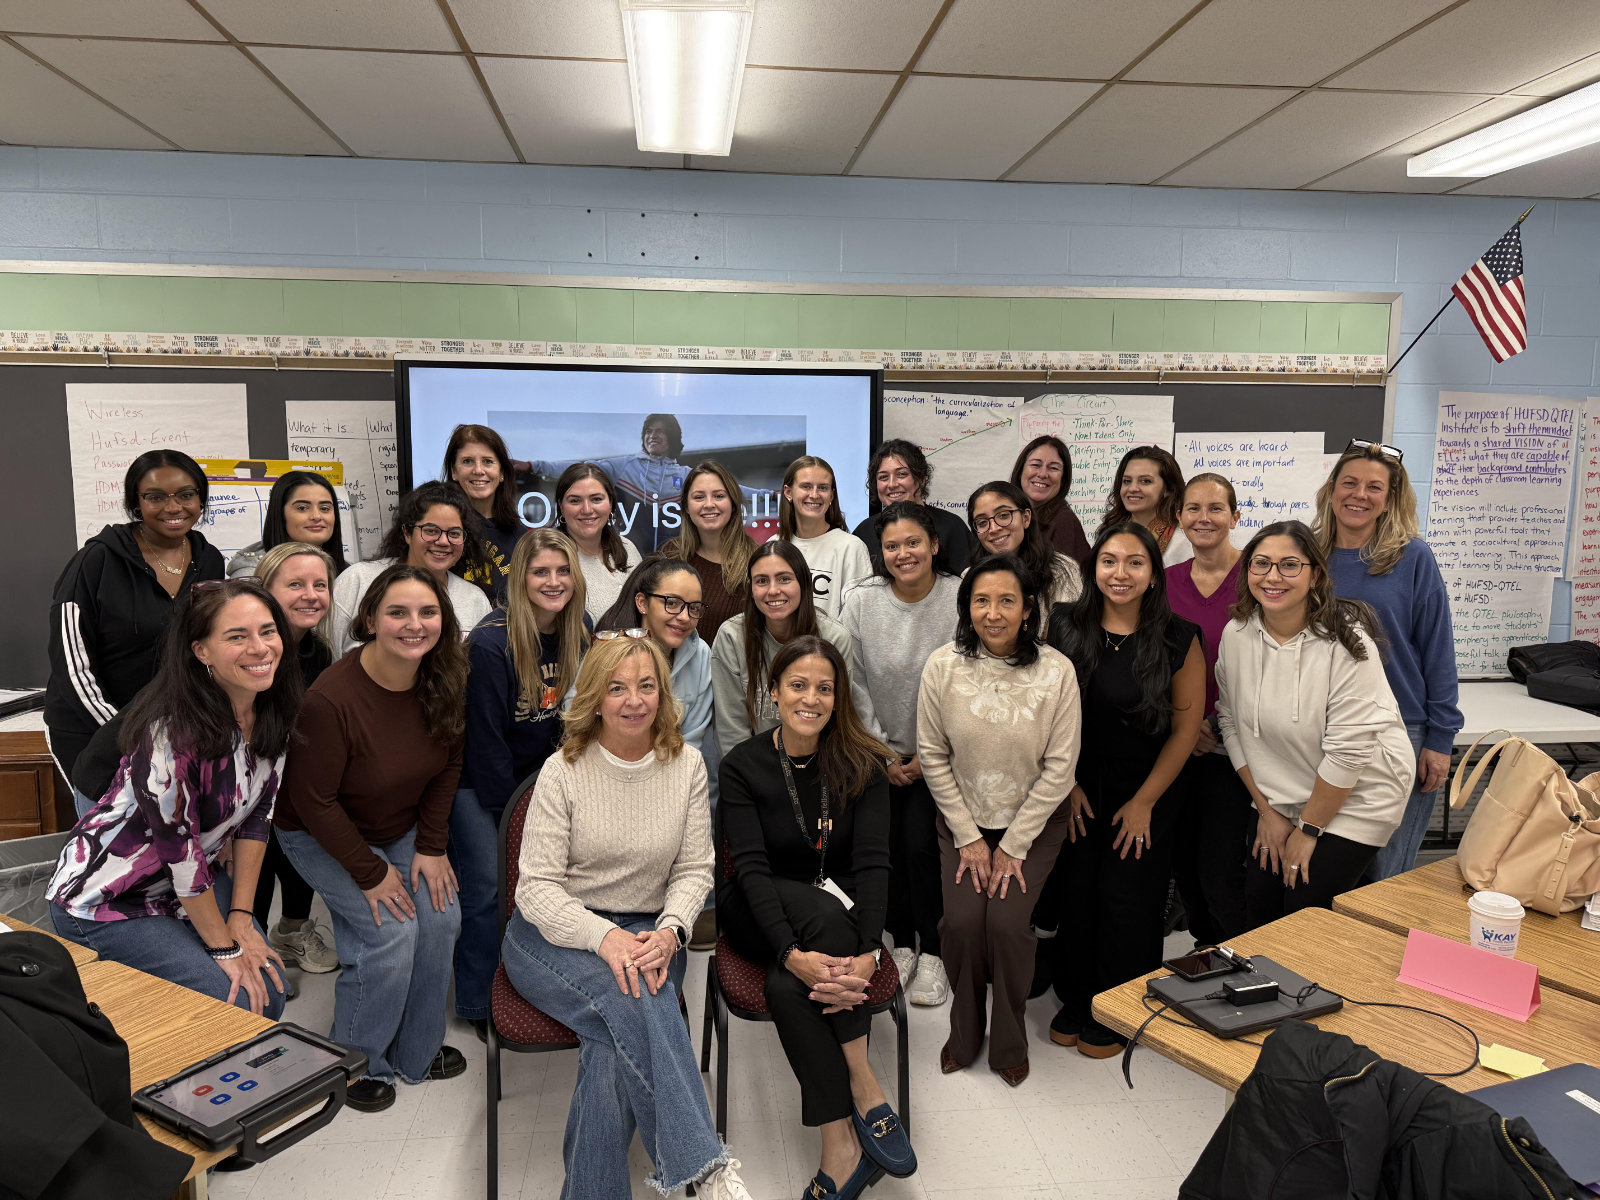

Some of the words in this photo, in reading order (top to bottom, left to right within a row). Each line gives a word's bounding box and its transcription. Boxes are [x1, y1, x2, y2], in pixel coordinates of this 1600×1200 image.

[1050, 396, 1064, 408] The
[1077, 395, 1108, 409] Circuit
[84, 401, 143, 419] Wireless
[1442, 404, 1461, 419] The
[1464, 409, 1498, 425] purpose
[1501, 407, 1512, 420] of
[1514, 407, 1548, 423] HUFSD
[1550, 408, 1574, 424] QTEL
[288, 419, 317, 434] What
[322, 419, 331, 432] it
[370, 421, 393, 433] What
[1481, 423, 1488, 433] is
[1491, 421, 1500, 434] to
[1504, 422, 1527, 435] shift
[92, 428, 192, 450] Hufsd-Event
[1074, 432, 1092, 442] Novel
[1118, 430, 1135, 443] Only
[1437, 437, 1470, 448] towards
[1482, 437, 1511, 448] shared
[1514, 438, 1544, 448] VISION
[1547, 439, 1559, 448] of
[291, 442, 335, 459] temporary
[378, 443, 396, 457] rigid
[1069, 445, 1106, 459] Clarifying
[1188, 440, 1201, 453] All
[1206, 442, 1234, 452] voices
[1239, 443, 1255, 452] are
[1259, 440, 1288, 452] heard
[1469, 451, 1489, 460] what
[1492, 451, 1508, 463] they
[1511, 452, 1524, 460] are
[1526, 451, 1560, 462] capable
[1072, 460, 1090, 469] ouble
[1207, 458, 1231, 468] voices
[1236, 459, 1250, 468] are
[1252, 456, 1295, 473] important
[1478, 461, 1522, 474] background
[1525, 461, 1566, 474] contributes
[1072, 475, 1087, 484] ound
[1434, 478, 1443, 486] to
[1445, 477, 1458, 486] the
[1461, 475, 1482, 488] depth
[1485, 473, 1493, 484] of
[1530, 473, 1562, 487] learning
[653, 494, 681, 528] is
[1261, 497, 1287, 514] through
[1290, 501, 1309, 515] peers
[1432, 502, 1448, 512] The
[1479, 503, 1492, 512] will
[1494, 504, 1518, 513] include
[1430, 516, 1465, 528] learning
[1467, 513, 1486, 523] that
[1583, 515, 1594, 523] the
[1453, 529, 1472, 537] with
[1474, 525, 1507, 537] powerful
[1510, 527, 1528, 535] tools
[1531, 527, 1551, 536] that
[1472, 538, 1520, 547] sociocultural
[1509, 550, 1528, 559] This
[1459, 562, 1490, 571] learning
[1493, 561, 1503, 572] by
[1453, 578, 1461, 588] of
[1456, 608, 1469, 618] the
[1472, 608, 1498, 619] QTEL
[1502, 608, 1544, 623] philosophy
[1574, 611, 1588, 620] The
[1472, 622, 1480, 630] to
[1504, 621, 1538, 630] students
[1575, 626, 1599, 639] learning
[1484, 649, 1500, 658] talk
[1494, 933, 1517, 942] KAY
